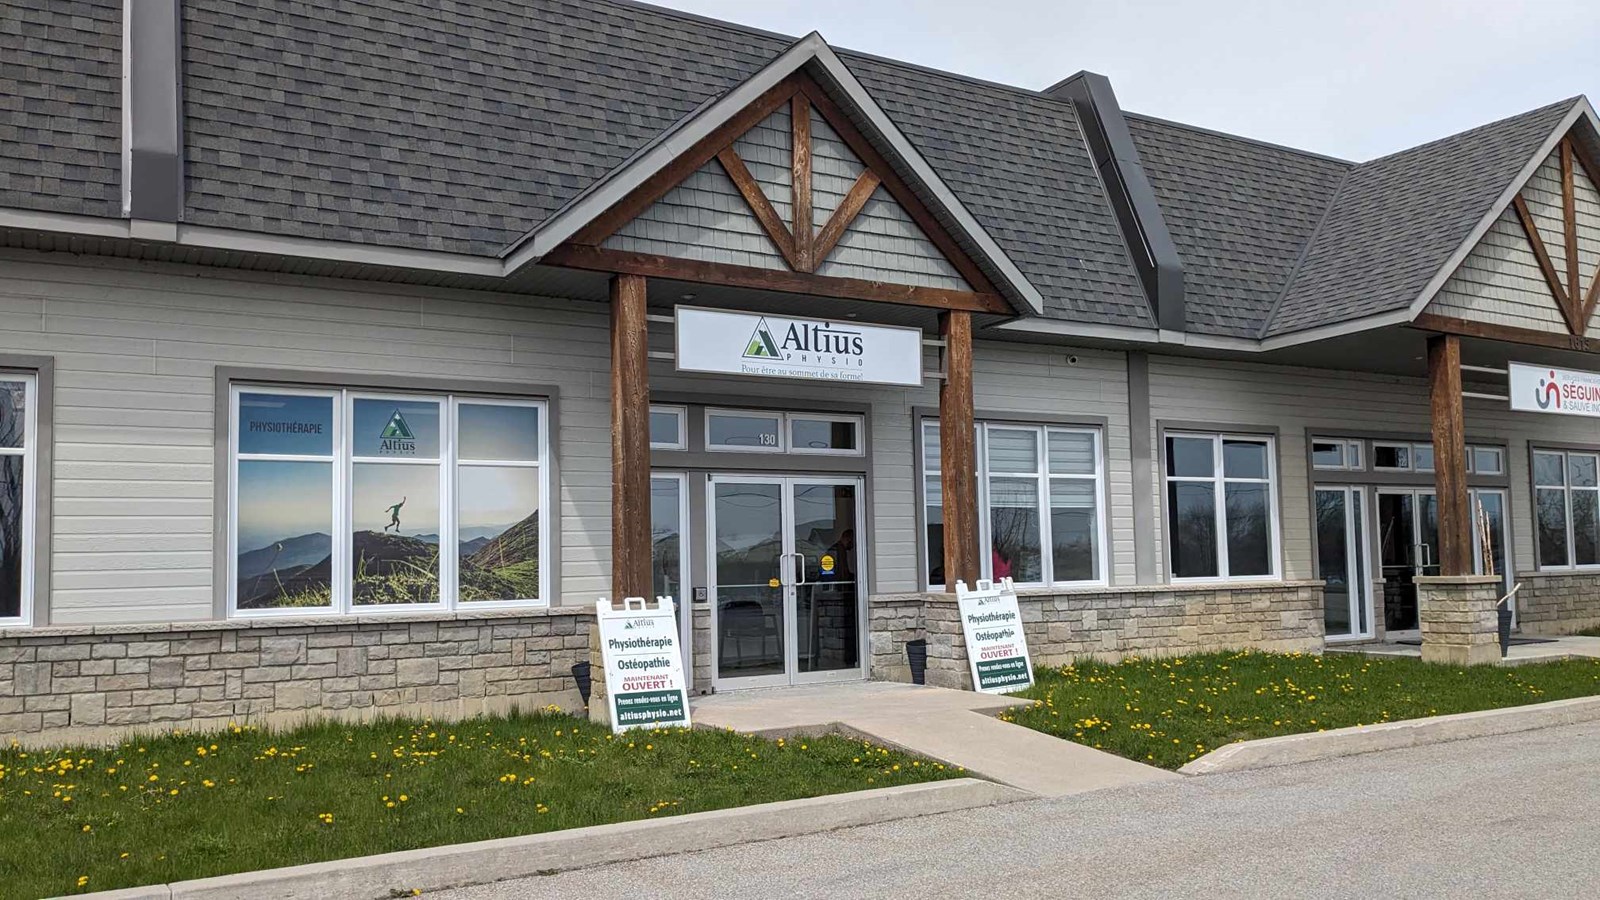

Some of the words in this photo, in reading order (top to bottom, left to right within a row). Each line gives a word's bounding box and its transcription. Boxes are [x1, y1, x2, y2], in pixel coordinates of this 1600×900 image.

[781, 322, 864, 355] Altius
[786, 353, 863, 366] PHYSIO
[741, 364, 760, 373] Pour
[761, 365, 776, 374] être
[788, 369, 819, 377] sommet
[820, 369, 829, 377] de
[1562, 381, 1600, 402] SÉGUIN
[1563, 400, 1568, 409] &
[250, 421, 323, 434] PHYSIOTHÉRAPIE
[380, 439, 415, 451] Altius
[758, 433, 776, 445] 130
[633, 618, 654, 627] Altius
[968, 610, 1016, 625] Physiothérapie
[975, 628, 1015, 642] Ostéopathie
[608, 636, 673, 652] Physiothérapie
[981, 643, 1015, 652] MAINTENANT
[980, 649, 1013, 660] OUVERT
[617, 656, 671, 671] Ostéopathie
[623, 674, 669, 682] MAINTENANT
[622, 680, 667, 691] OUVERT
[620, 709, 682, 720] altiusphysio.net
